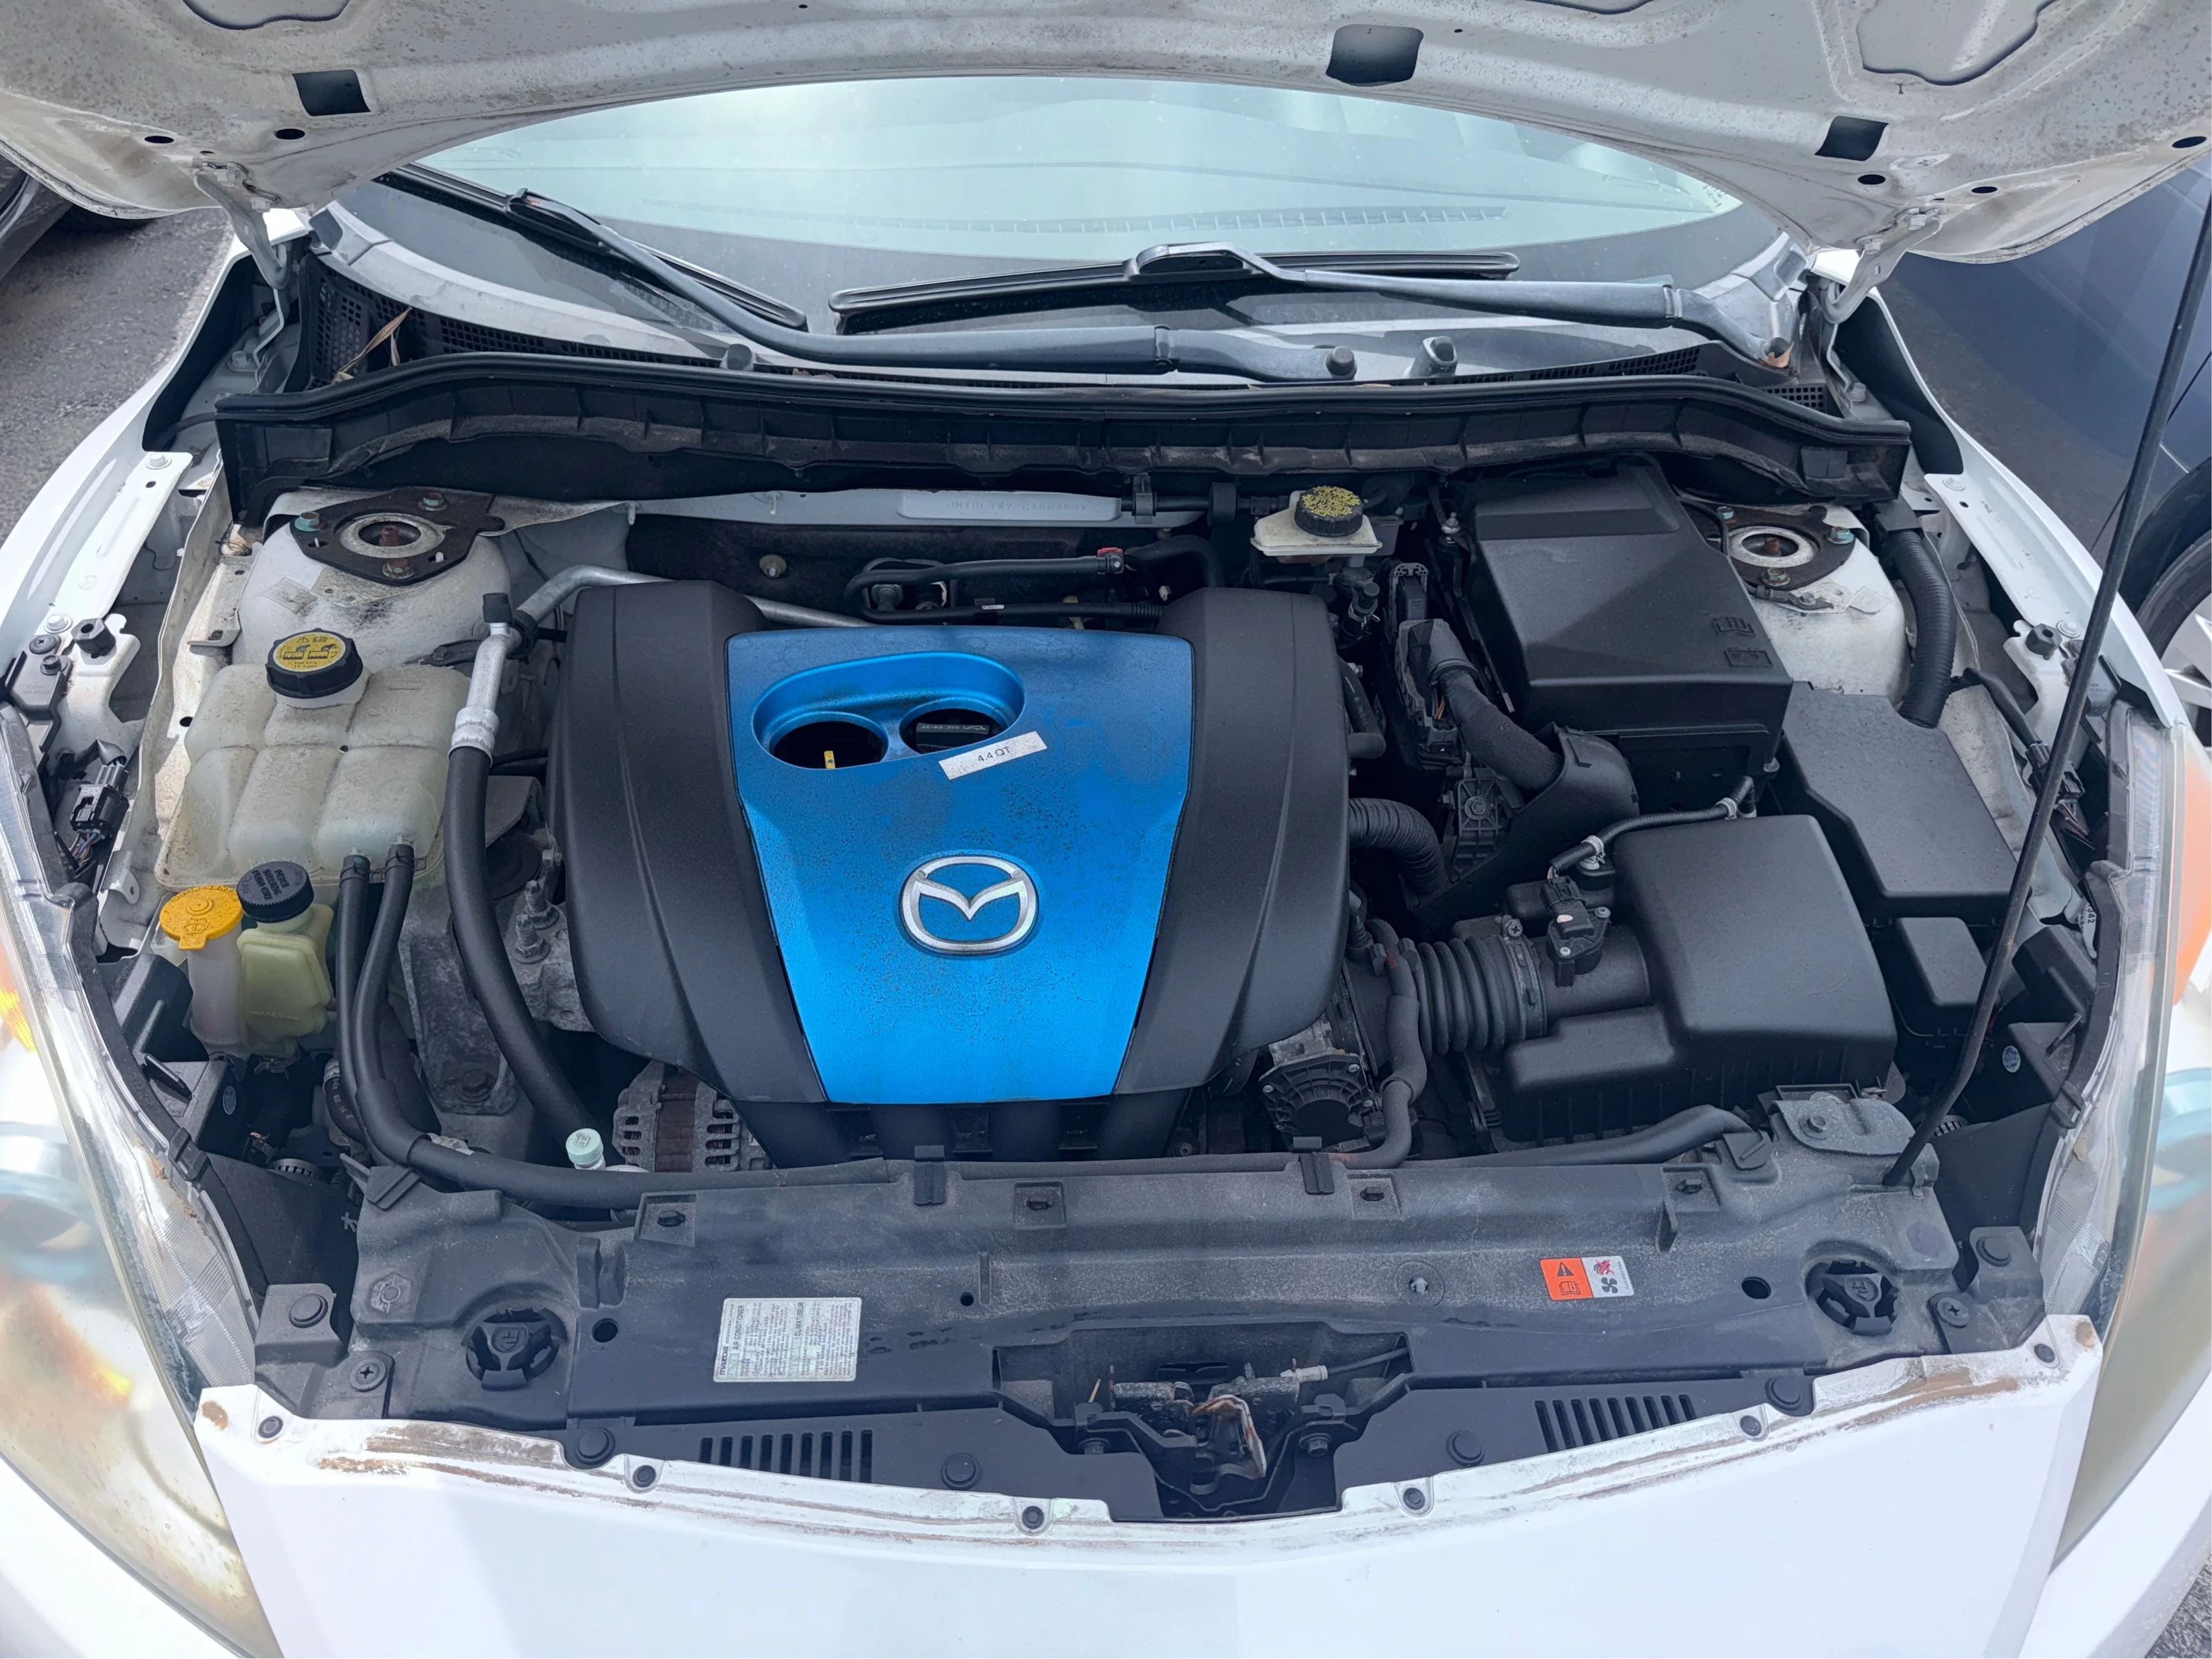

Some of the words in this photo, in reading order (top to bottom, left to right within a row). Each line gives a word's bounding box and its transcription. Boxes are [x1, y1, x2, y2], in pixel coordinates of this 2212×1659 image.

[978, 751, 994, 762] 4.4
[995, 746, 1010, 757] QT
[576, 1136, 589, 1146] H
[734, 1305, 744, 1339] CONDITIONER
[794, 1302, 804, 1336] CLIMATISEUR
[719, 1346, 729, 1375] mazda
